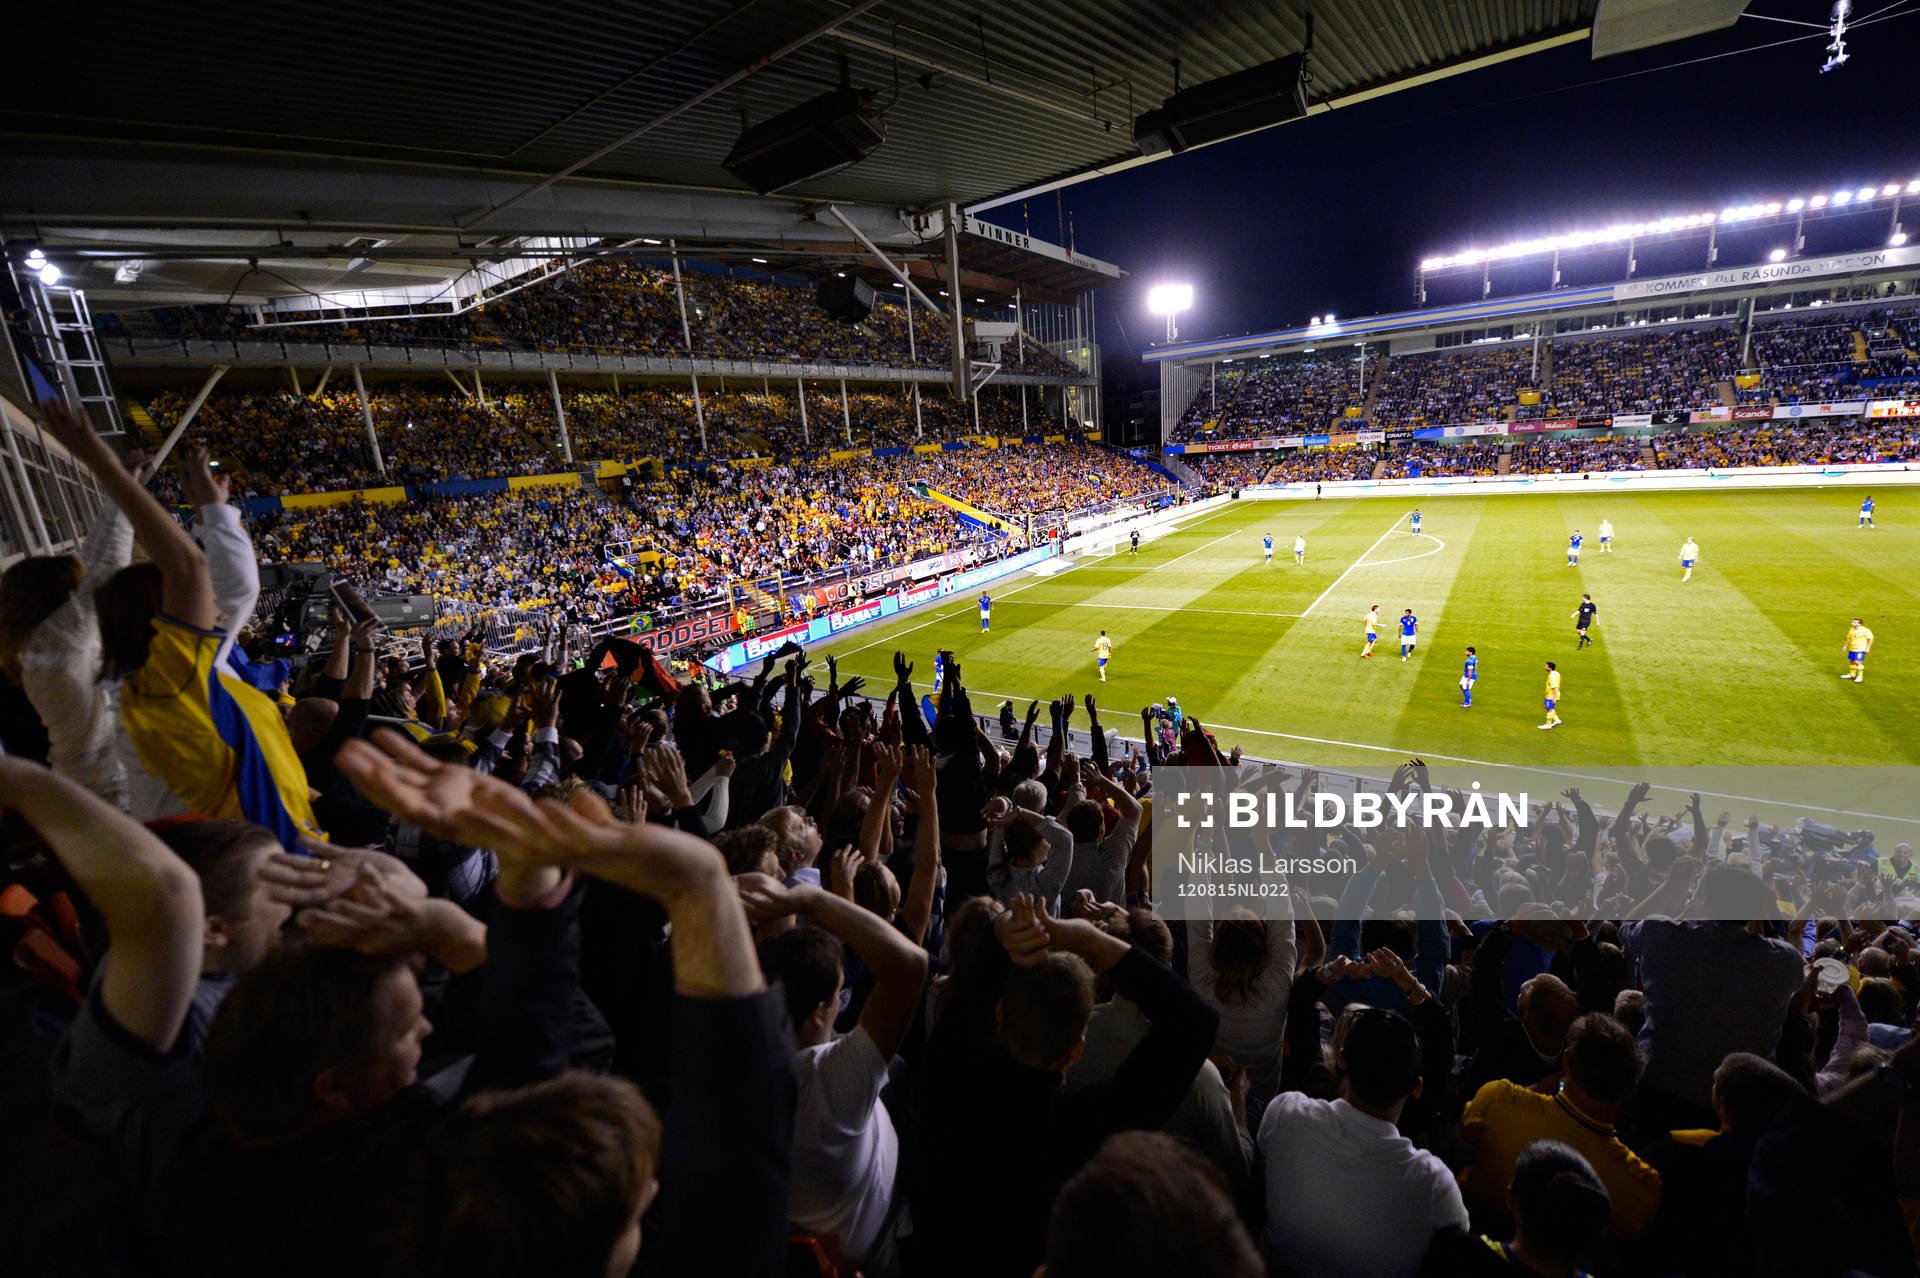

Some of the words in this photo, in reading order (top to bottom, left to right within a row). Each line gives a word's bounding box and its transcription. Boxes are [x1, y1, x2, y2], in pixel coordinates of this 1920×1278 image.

[978, 222, 1030, 249] VINNER
[1735, 409, 1770, 418] Scandic
[1484, 424, 1499, 433] ICA
[638, 611, 735, 653] ODDSET
